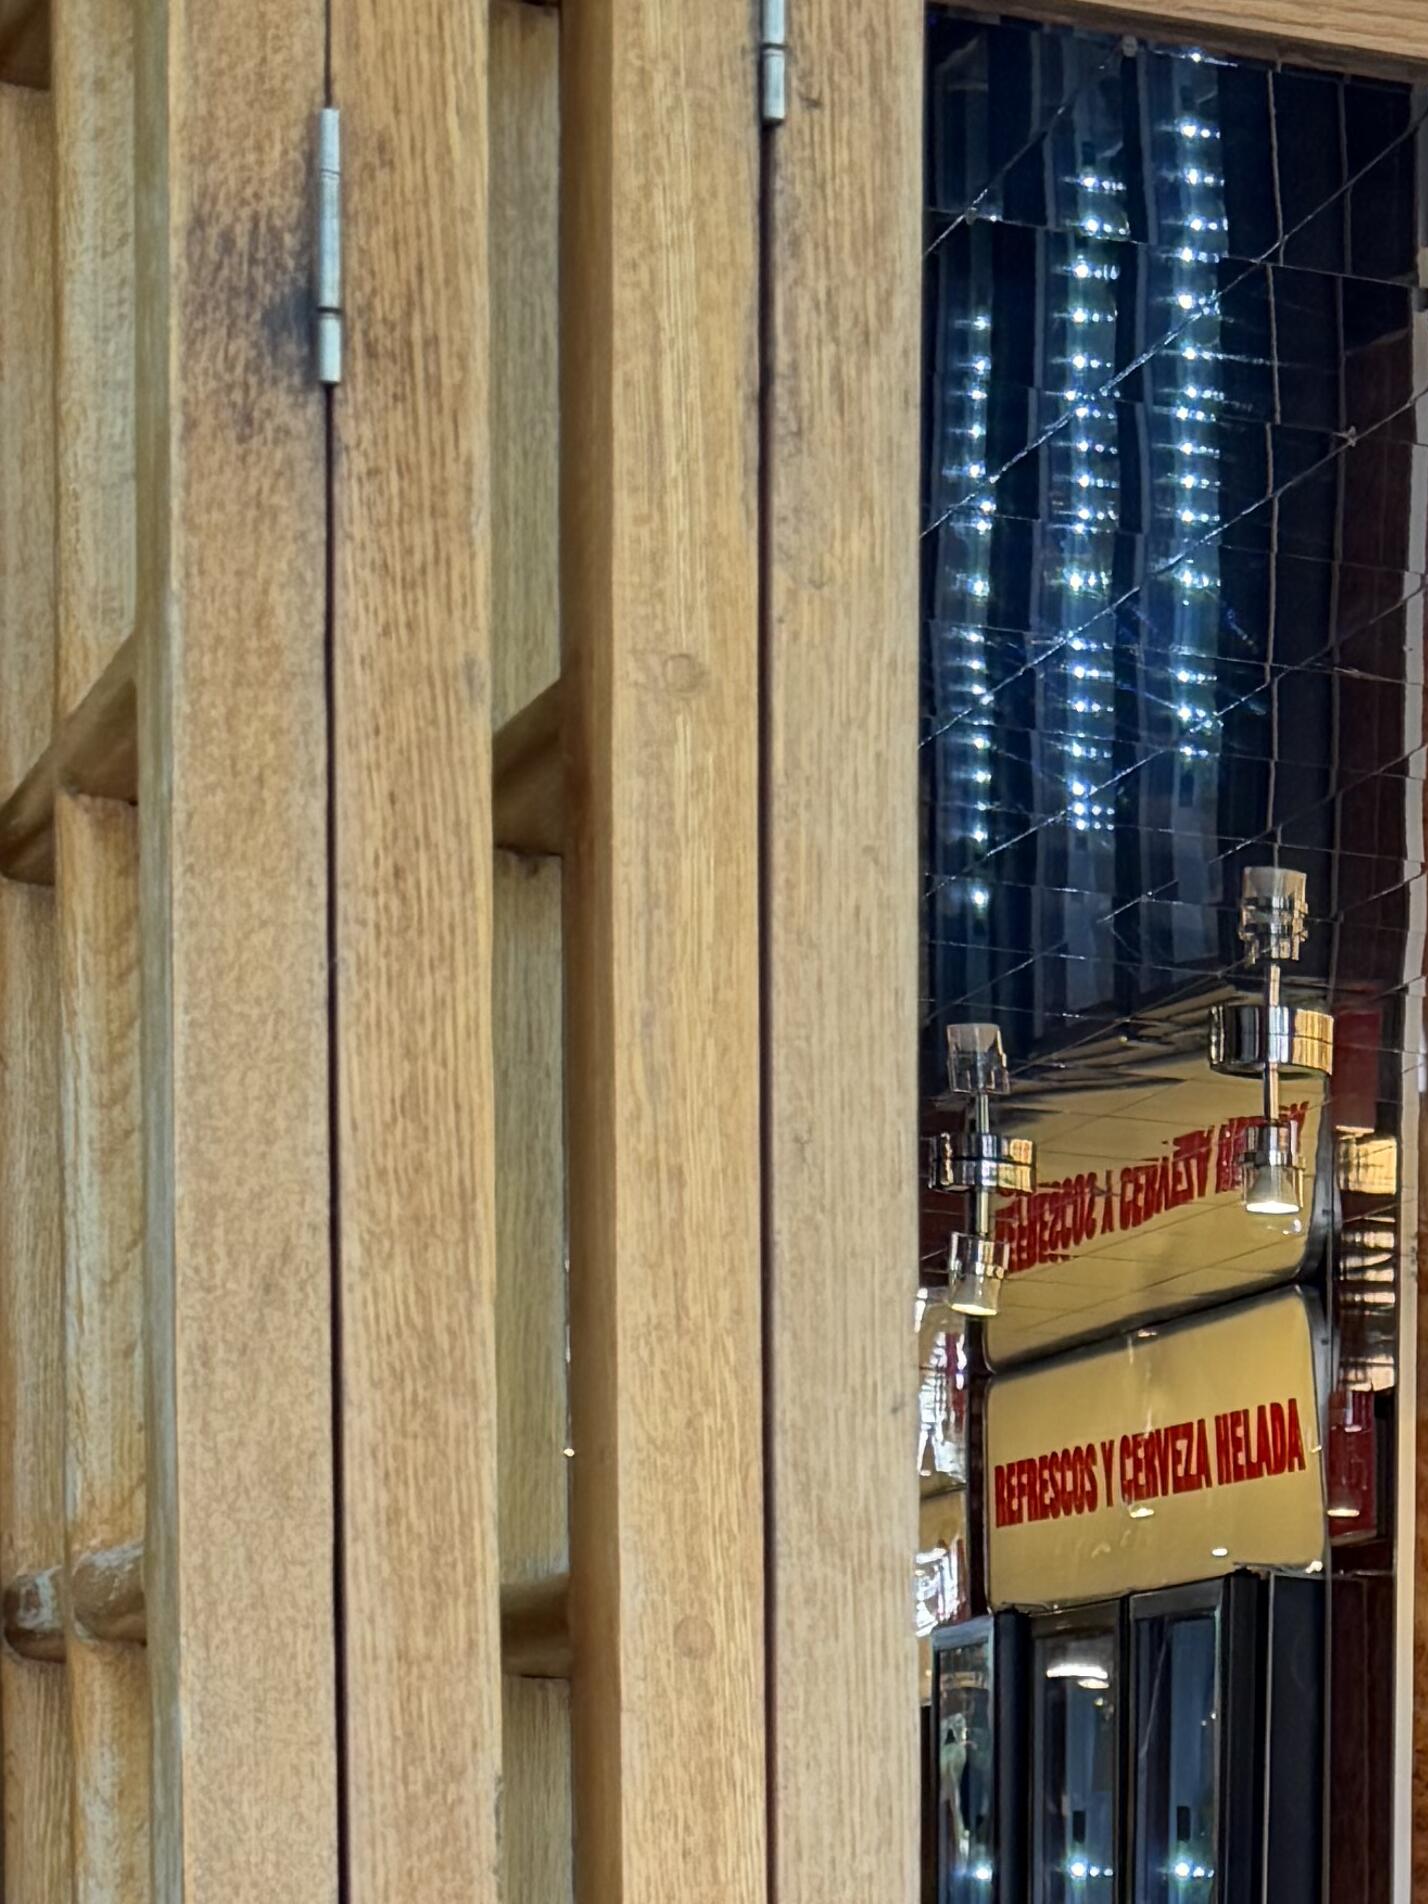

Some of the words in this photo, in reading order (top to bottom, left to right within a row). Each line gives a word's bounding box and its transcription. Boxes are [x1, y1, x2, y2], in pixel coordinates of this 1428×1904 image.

[994, 1442, 1098, 1528] REFRESCOS
[1100, 1439, 1116, 1507] Y
[1119, 1418, 1213, 1505] CERVEZA
[1214, 1398, 1306, 1486] HELADA
